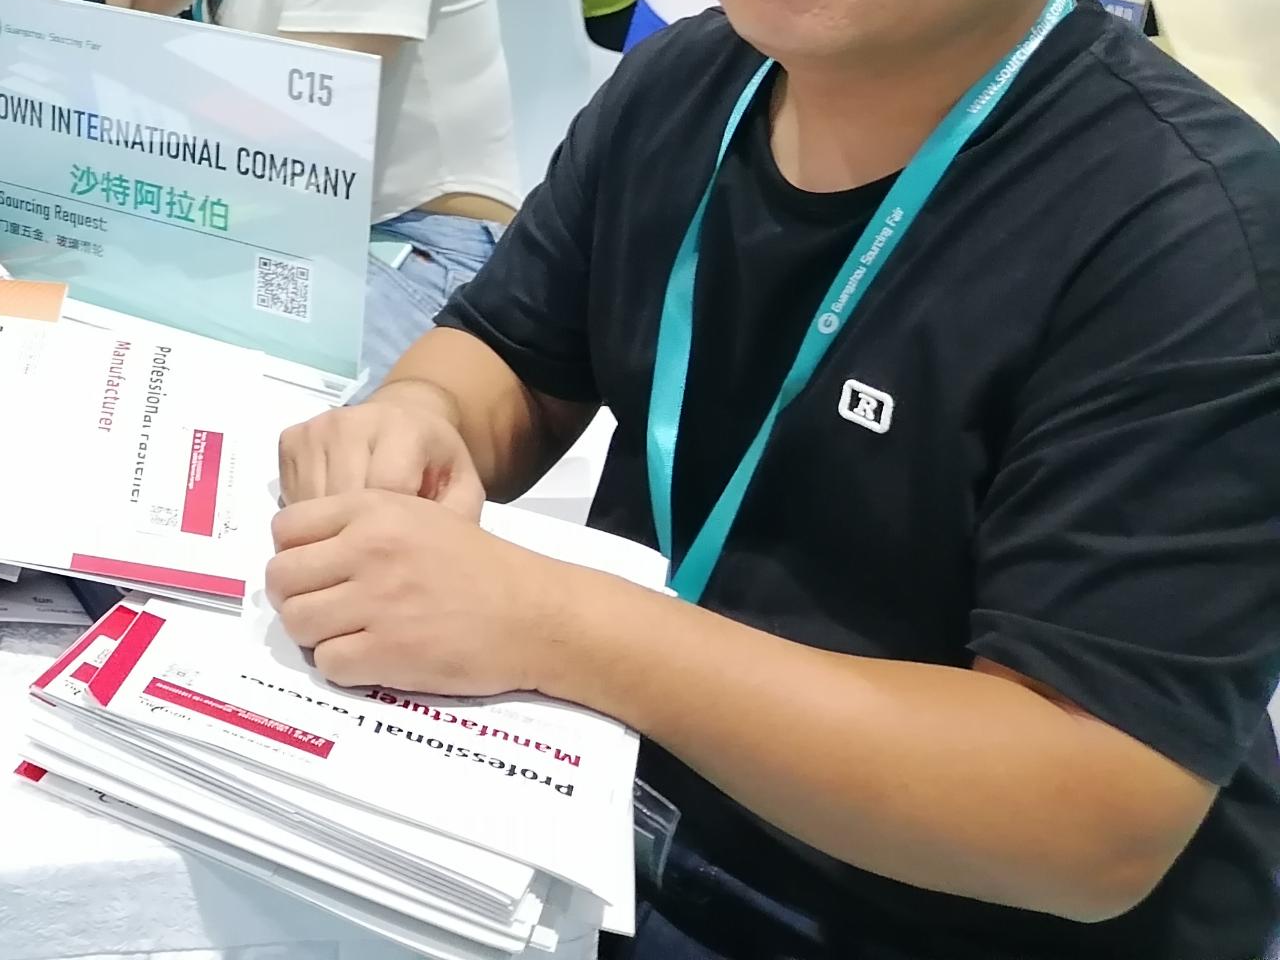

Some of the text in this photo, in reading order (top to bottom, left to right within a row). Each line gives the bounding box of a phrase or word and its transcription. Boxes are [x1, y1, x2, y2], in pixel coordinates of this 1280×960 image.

[288, 68, 334, 107] C15
[51, 104, 227, 171] INTERNATIONAL
[236, 147, 357, 201] COMPANY
[69, 163, 230, 232] 沙特阿拉伯
[831, 207, 904, 313] Guangzhou Sourcing Fair
[98, 340, 132, 433] Manufacturer
[368, 689, 582, 768] Manufacturer
[373, 718, 575, 798] Professional
